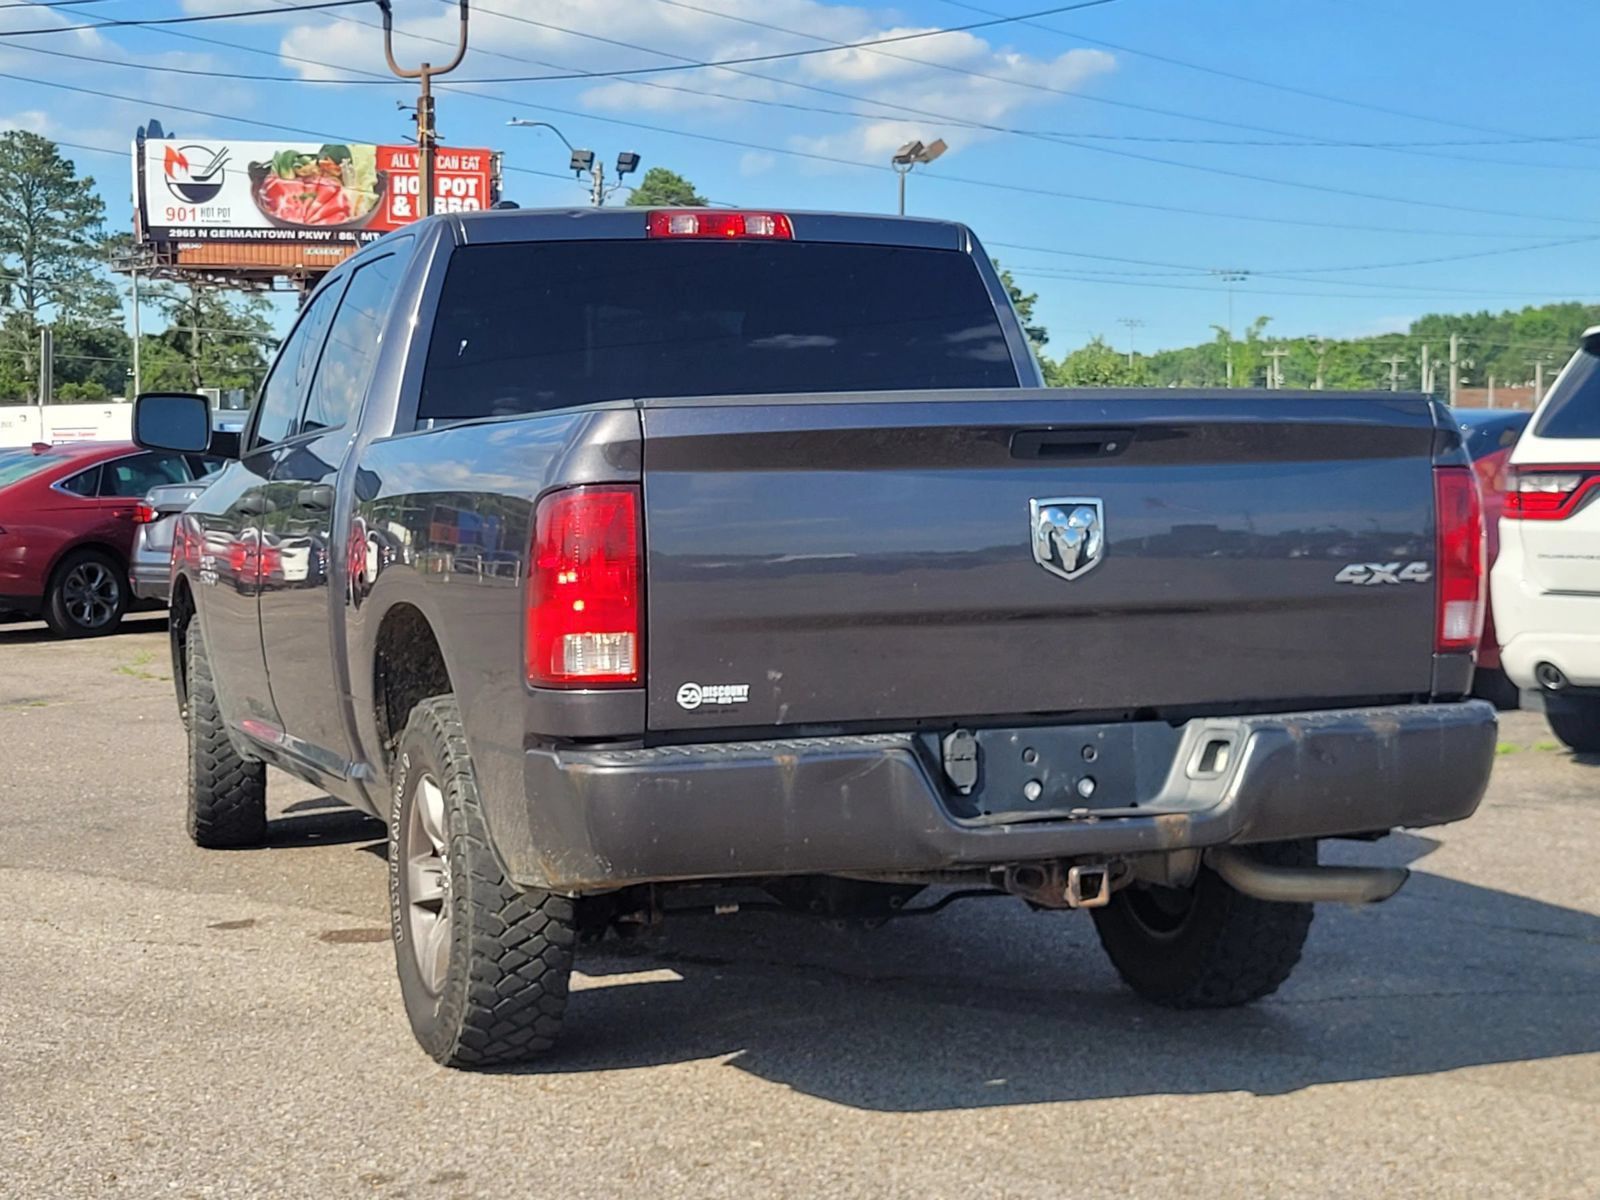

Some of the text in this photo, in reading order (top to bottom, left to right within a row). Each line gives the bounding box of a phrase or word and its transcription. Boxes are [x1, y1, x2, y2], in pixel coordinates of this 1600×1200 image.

[391, 153, 411, 168] ALL
[436, 155, 459, 169] CAN
[461, 156, 481, 170] EAT
[393, 175, 478, 196] HO POT
[165, 207, 231, 222] 901 HOT POT
[392, 196, 412, 217] &
[169, 229, 196, 237] 2965
[198, 229, 207, 238] N
[210, 229, 297, 239] GERMANTOWN
[298, 231, 331, 240] PKWY
